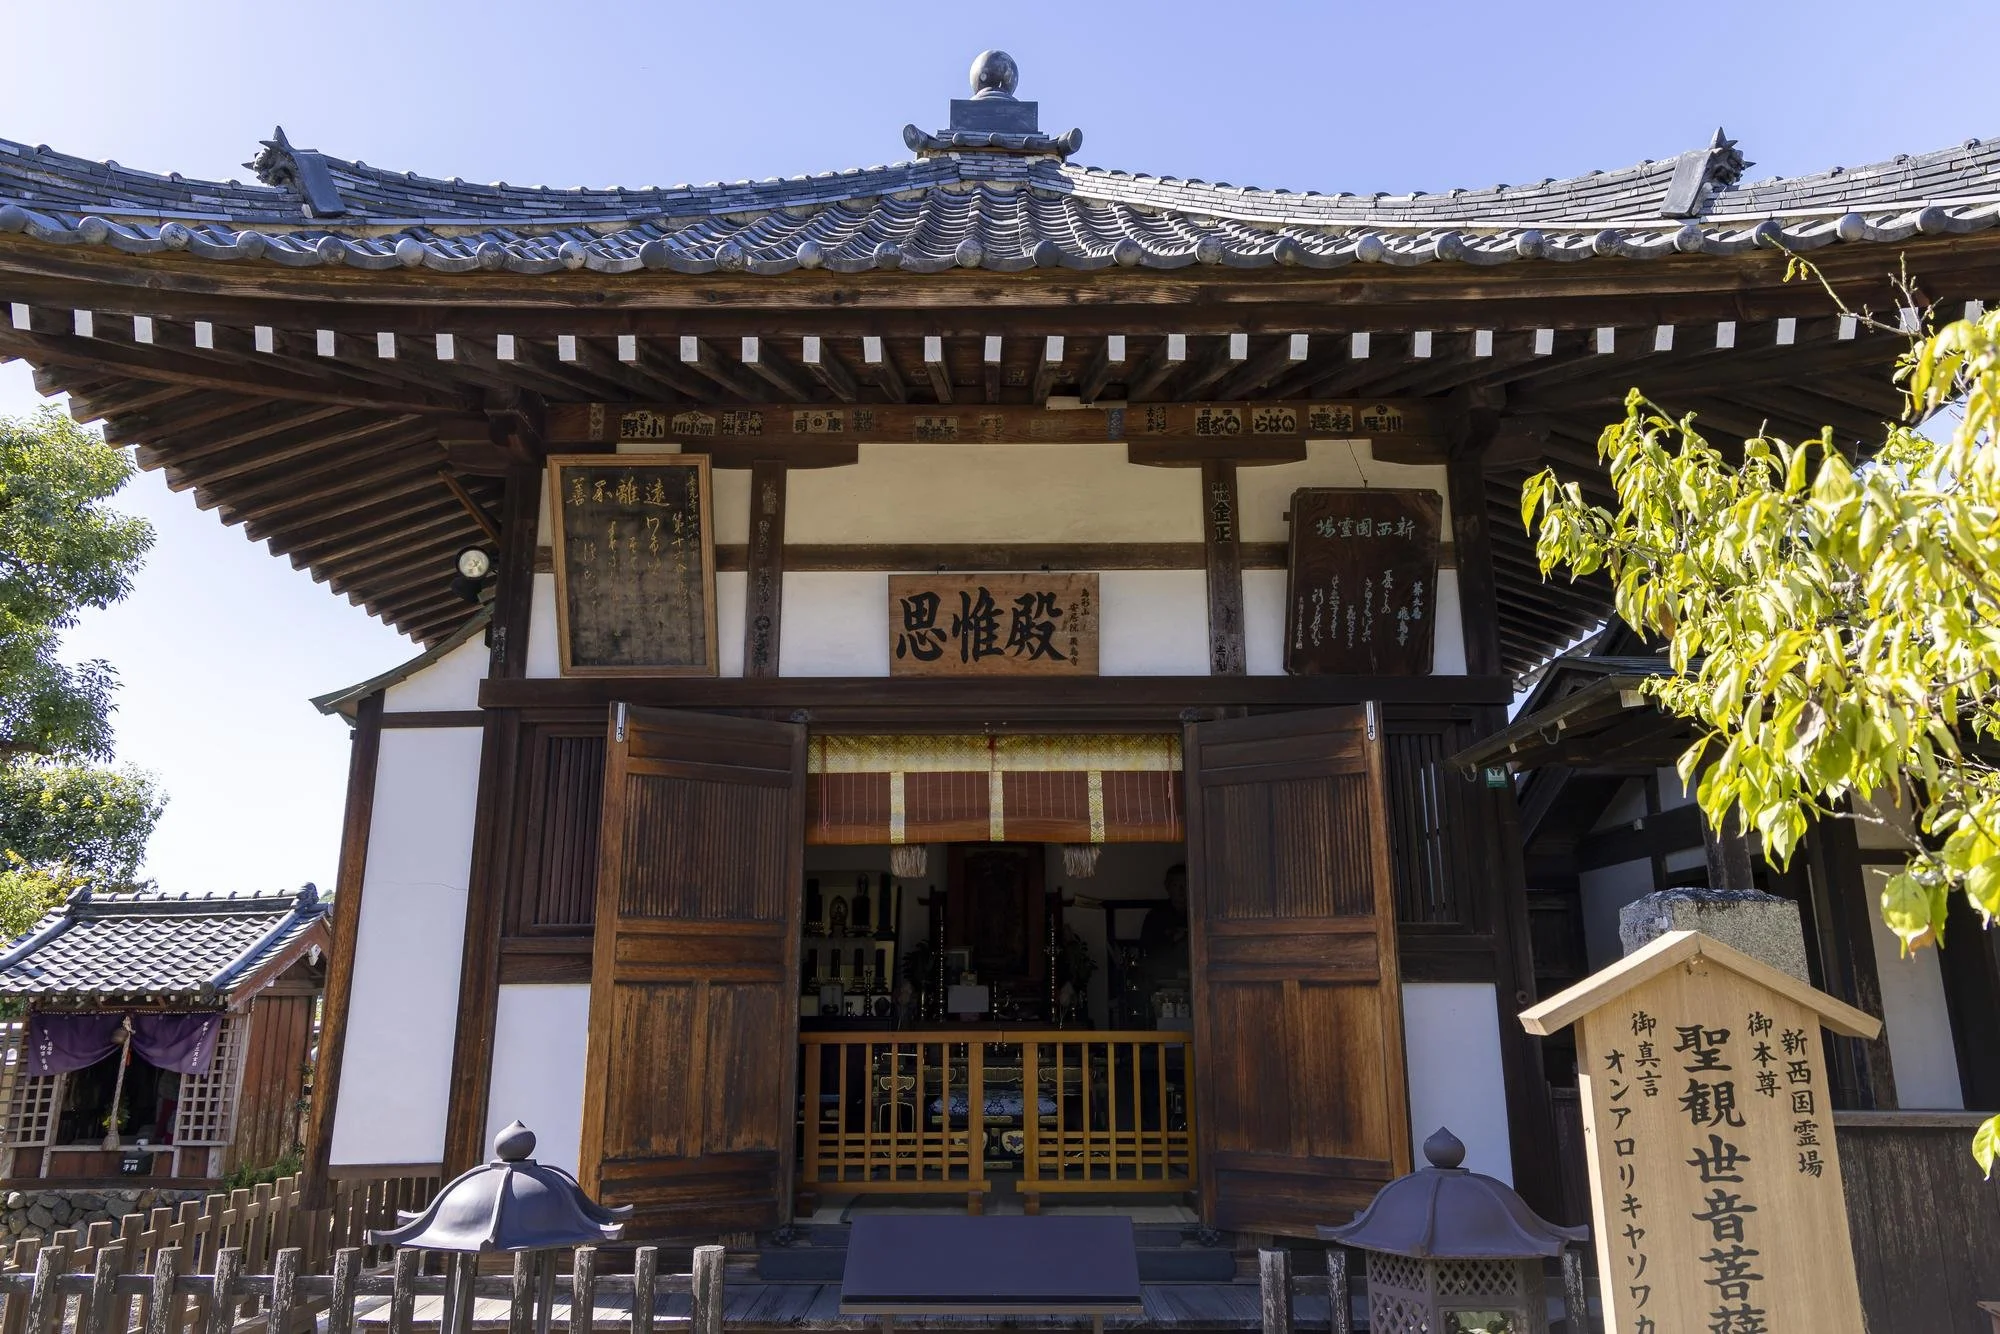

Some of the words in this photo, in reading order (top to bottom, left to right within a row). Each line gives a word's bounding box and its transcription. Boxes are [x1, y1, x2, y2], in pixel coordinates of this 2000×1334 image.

[896, 586, 1073, 664] 思惟殿
[1631, 1012, 1662, 1098] 御真言
[1747, 1012, 1782, 1099] 御本尊
[1780, 1028, 1825, 1178] 新西国霊場
[1673, 1024, 1769, 1334] 聖観世音菩薩
